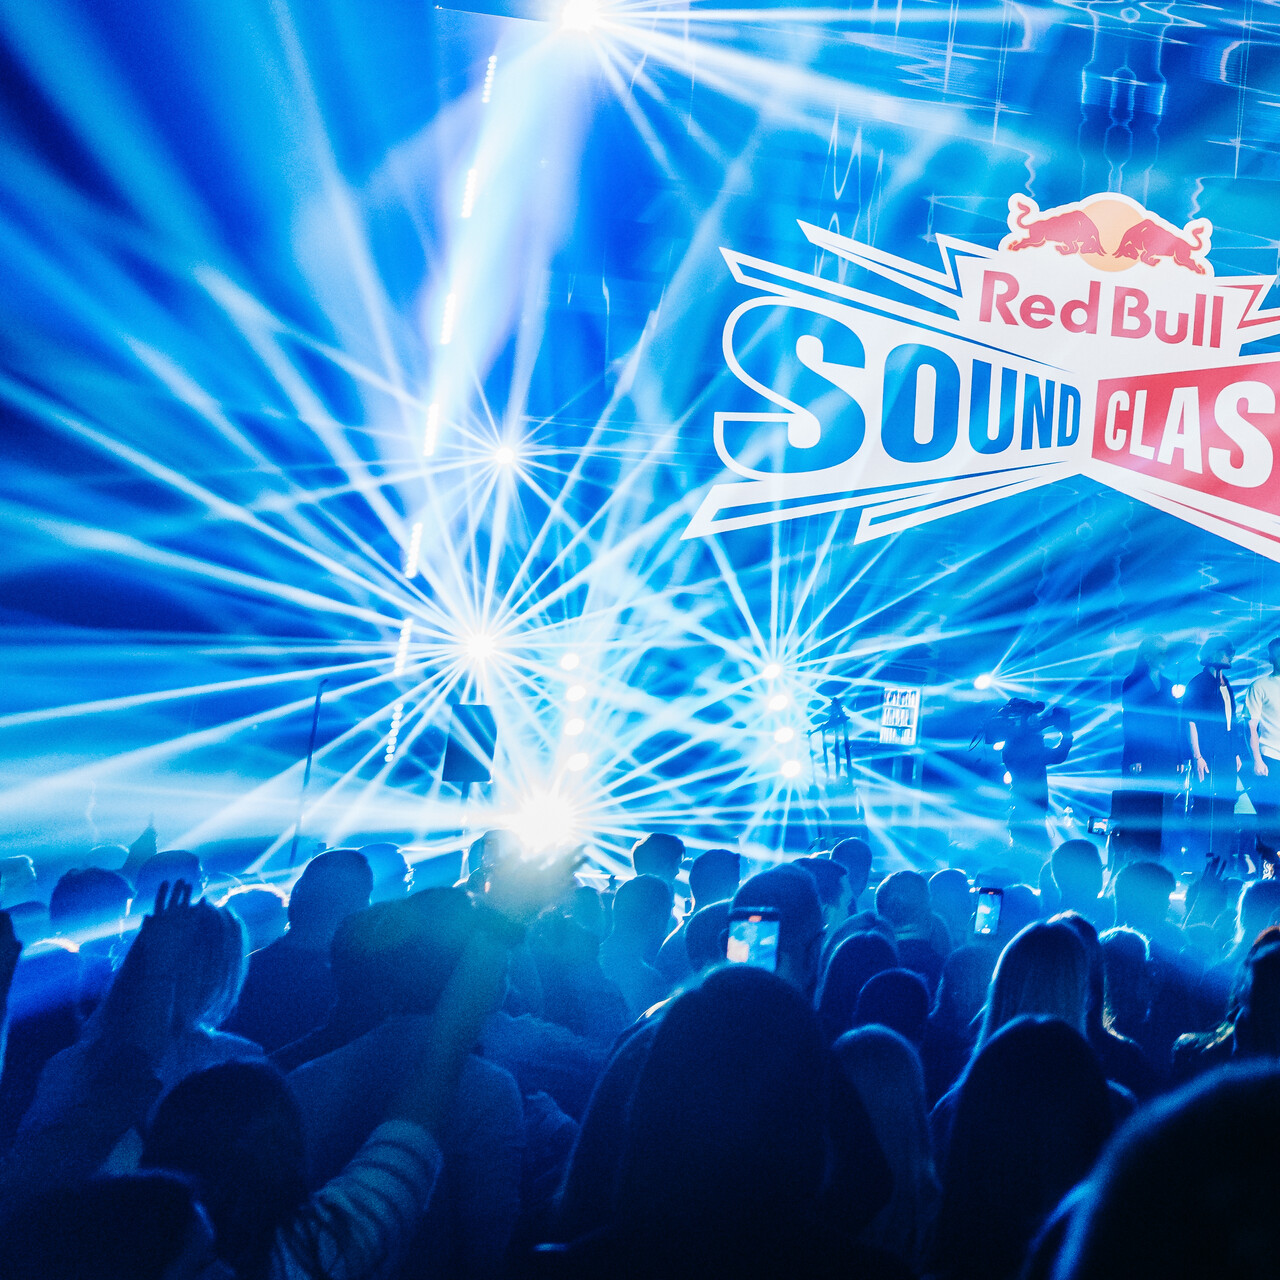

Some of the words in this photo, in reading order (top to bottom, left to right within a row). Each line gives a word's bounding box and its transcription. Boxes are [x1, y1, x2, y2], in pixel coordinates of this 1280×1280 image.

[979, 270, 1100, 334] Red
[1109, 284, 1223, 349] Bull
[720, 301, 1081, 474] SOUND
